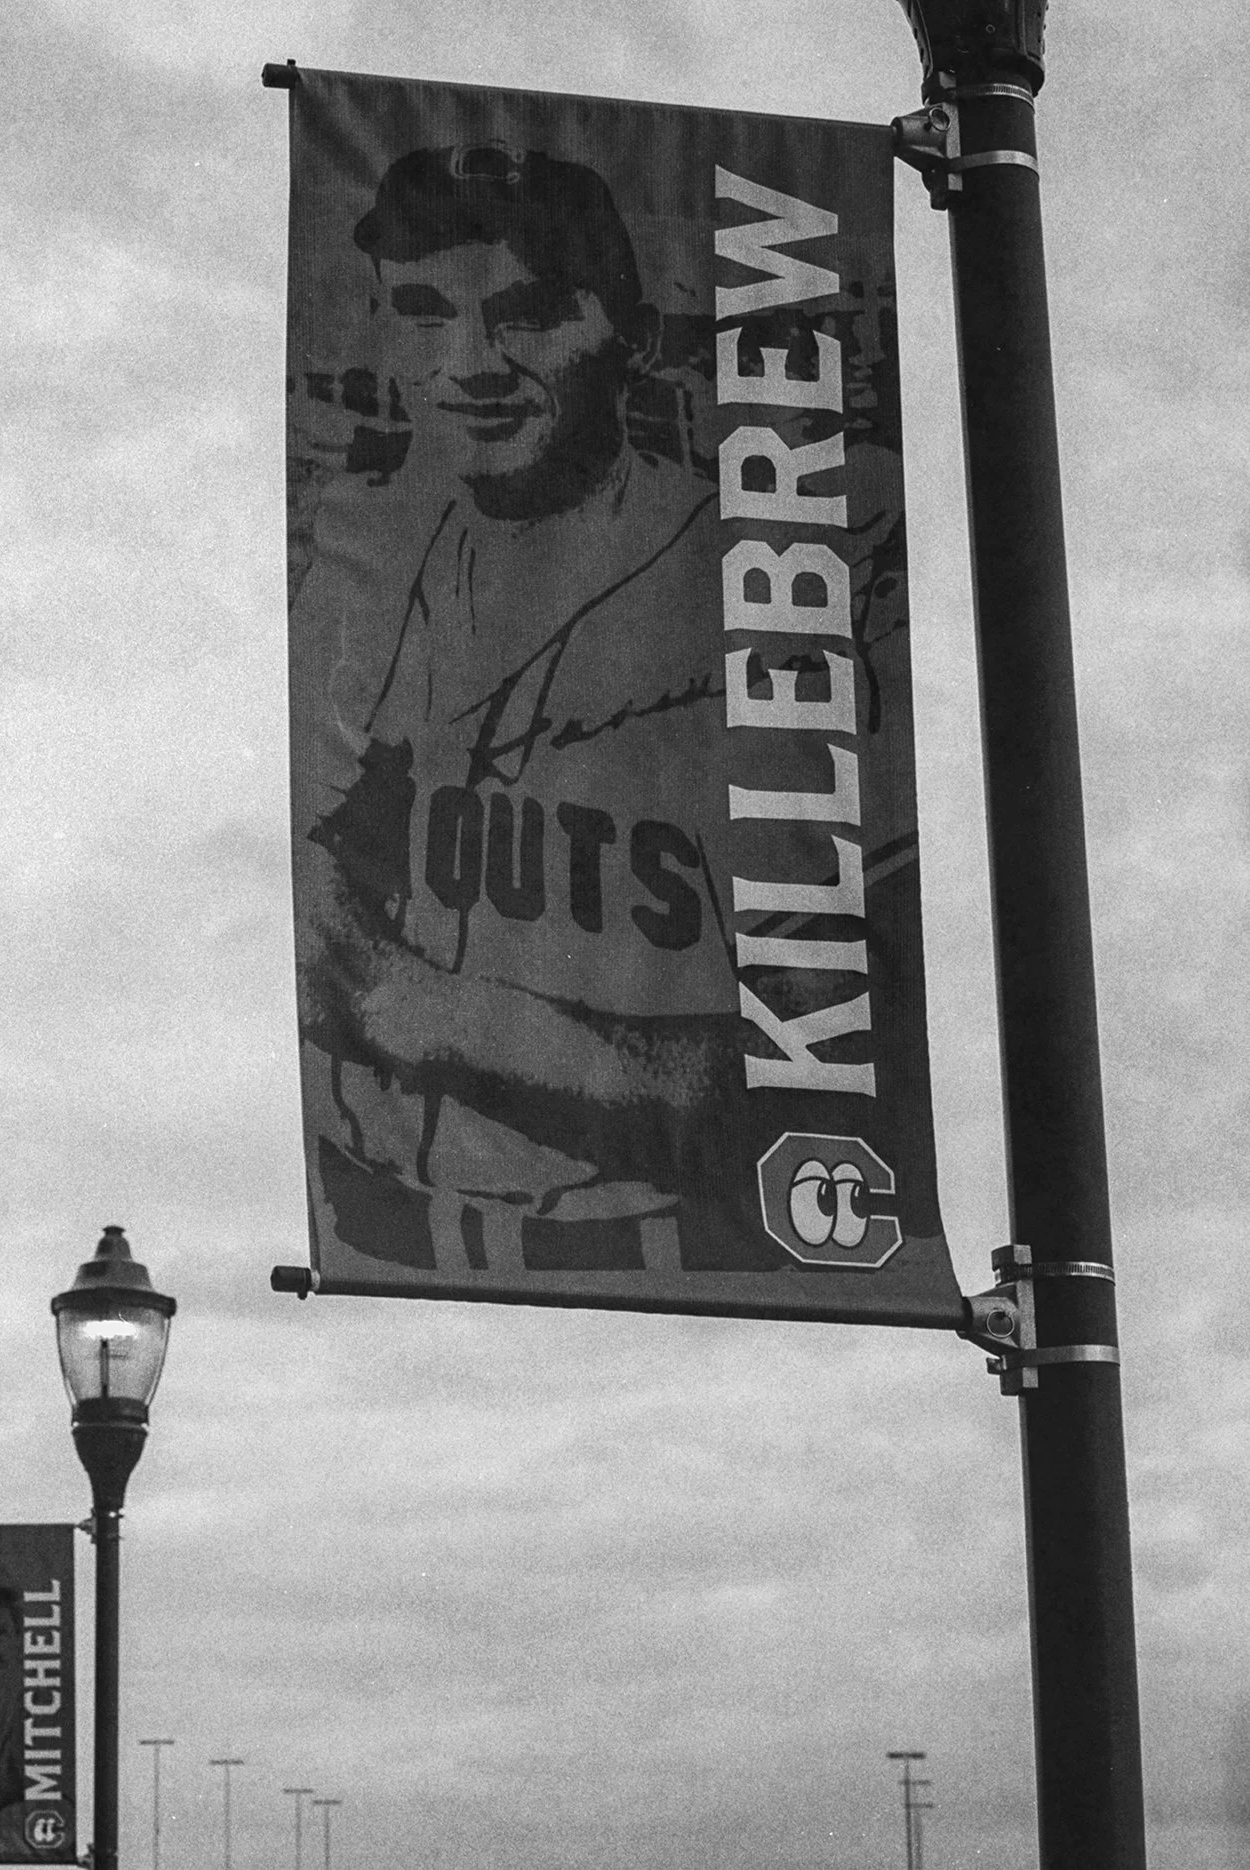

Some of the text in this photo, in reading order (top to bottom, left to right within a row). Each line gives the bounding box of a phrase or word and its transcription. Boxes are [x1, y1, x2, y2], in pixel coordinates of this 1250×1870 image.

[714, 164, 878, 1098] KILLEBREW
[426, 784, 702, 951] OUTS
[23, 1578, 62, 1801] MITCHELL
